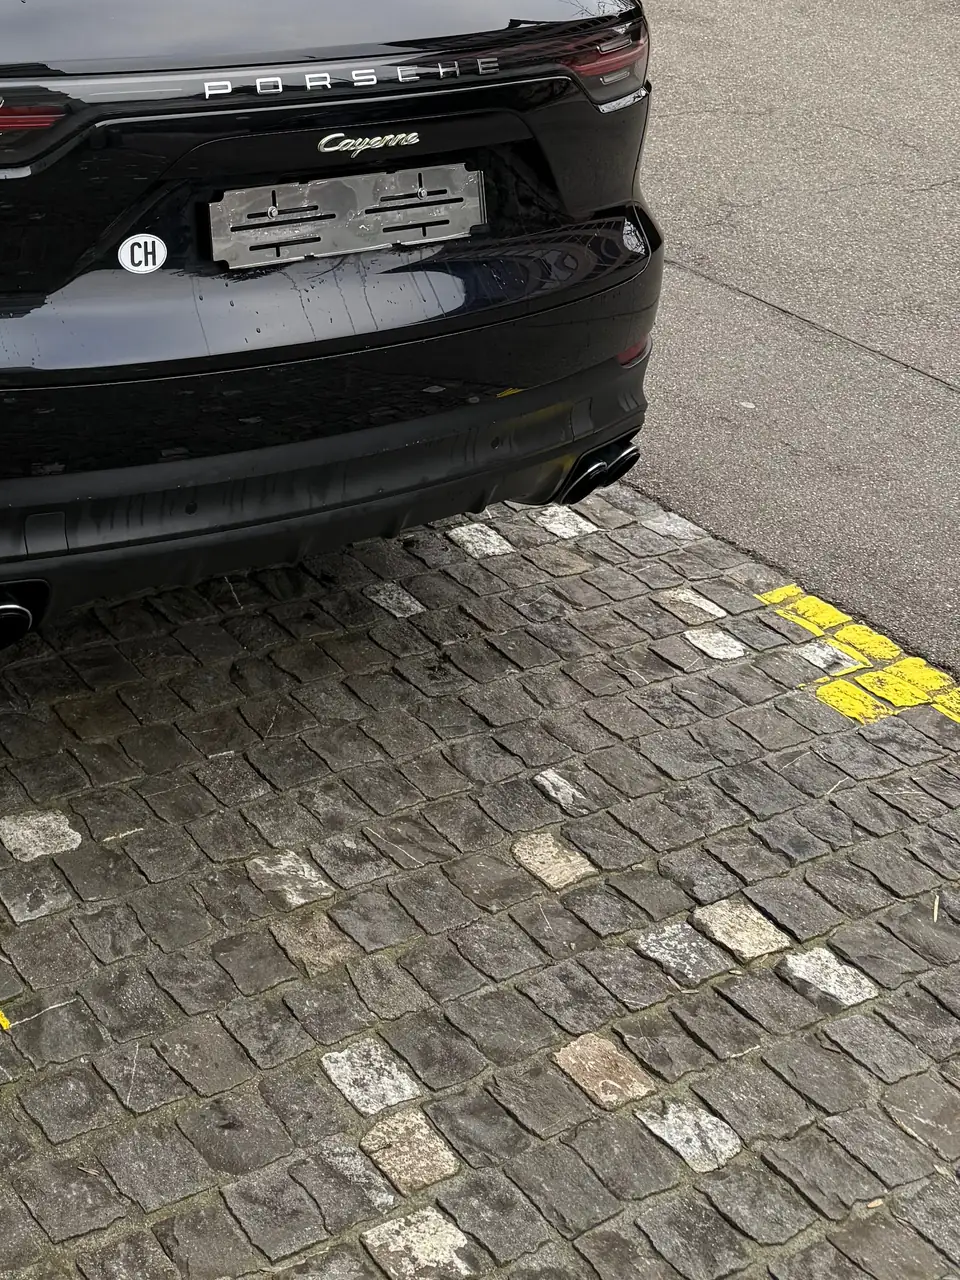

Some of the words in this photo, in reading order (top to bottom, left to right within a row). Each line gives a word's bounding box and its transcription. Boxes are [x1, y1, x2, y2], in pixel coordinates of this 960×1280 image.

[203, 57, 500, 100] PORSCHE
[317, 131, 420, 158] Cayenne
[130, 241, 157, 267] CH
